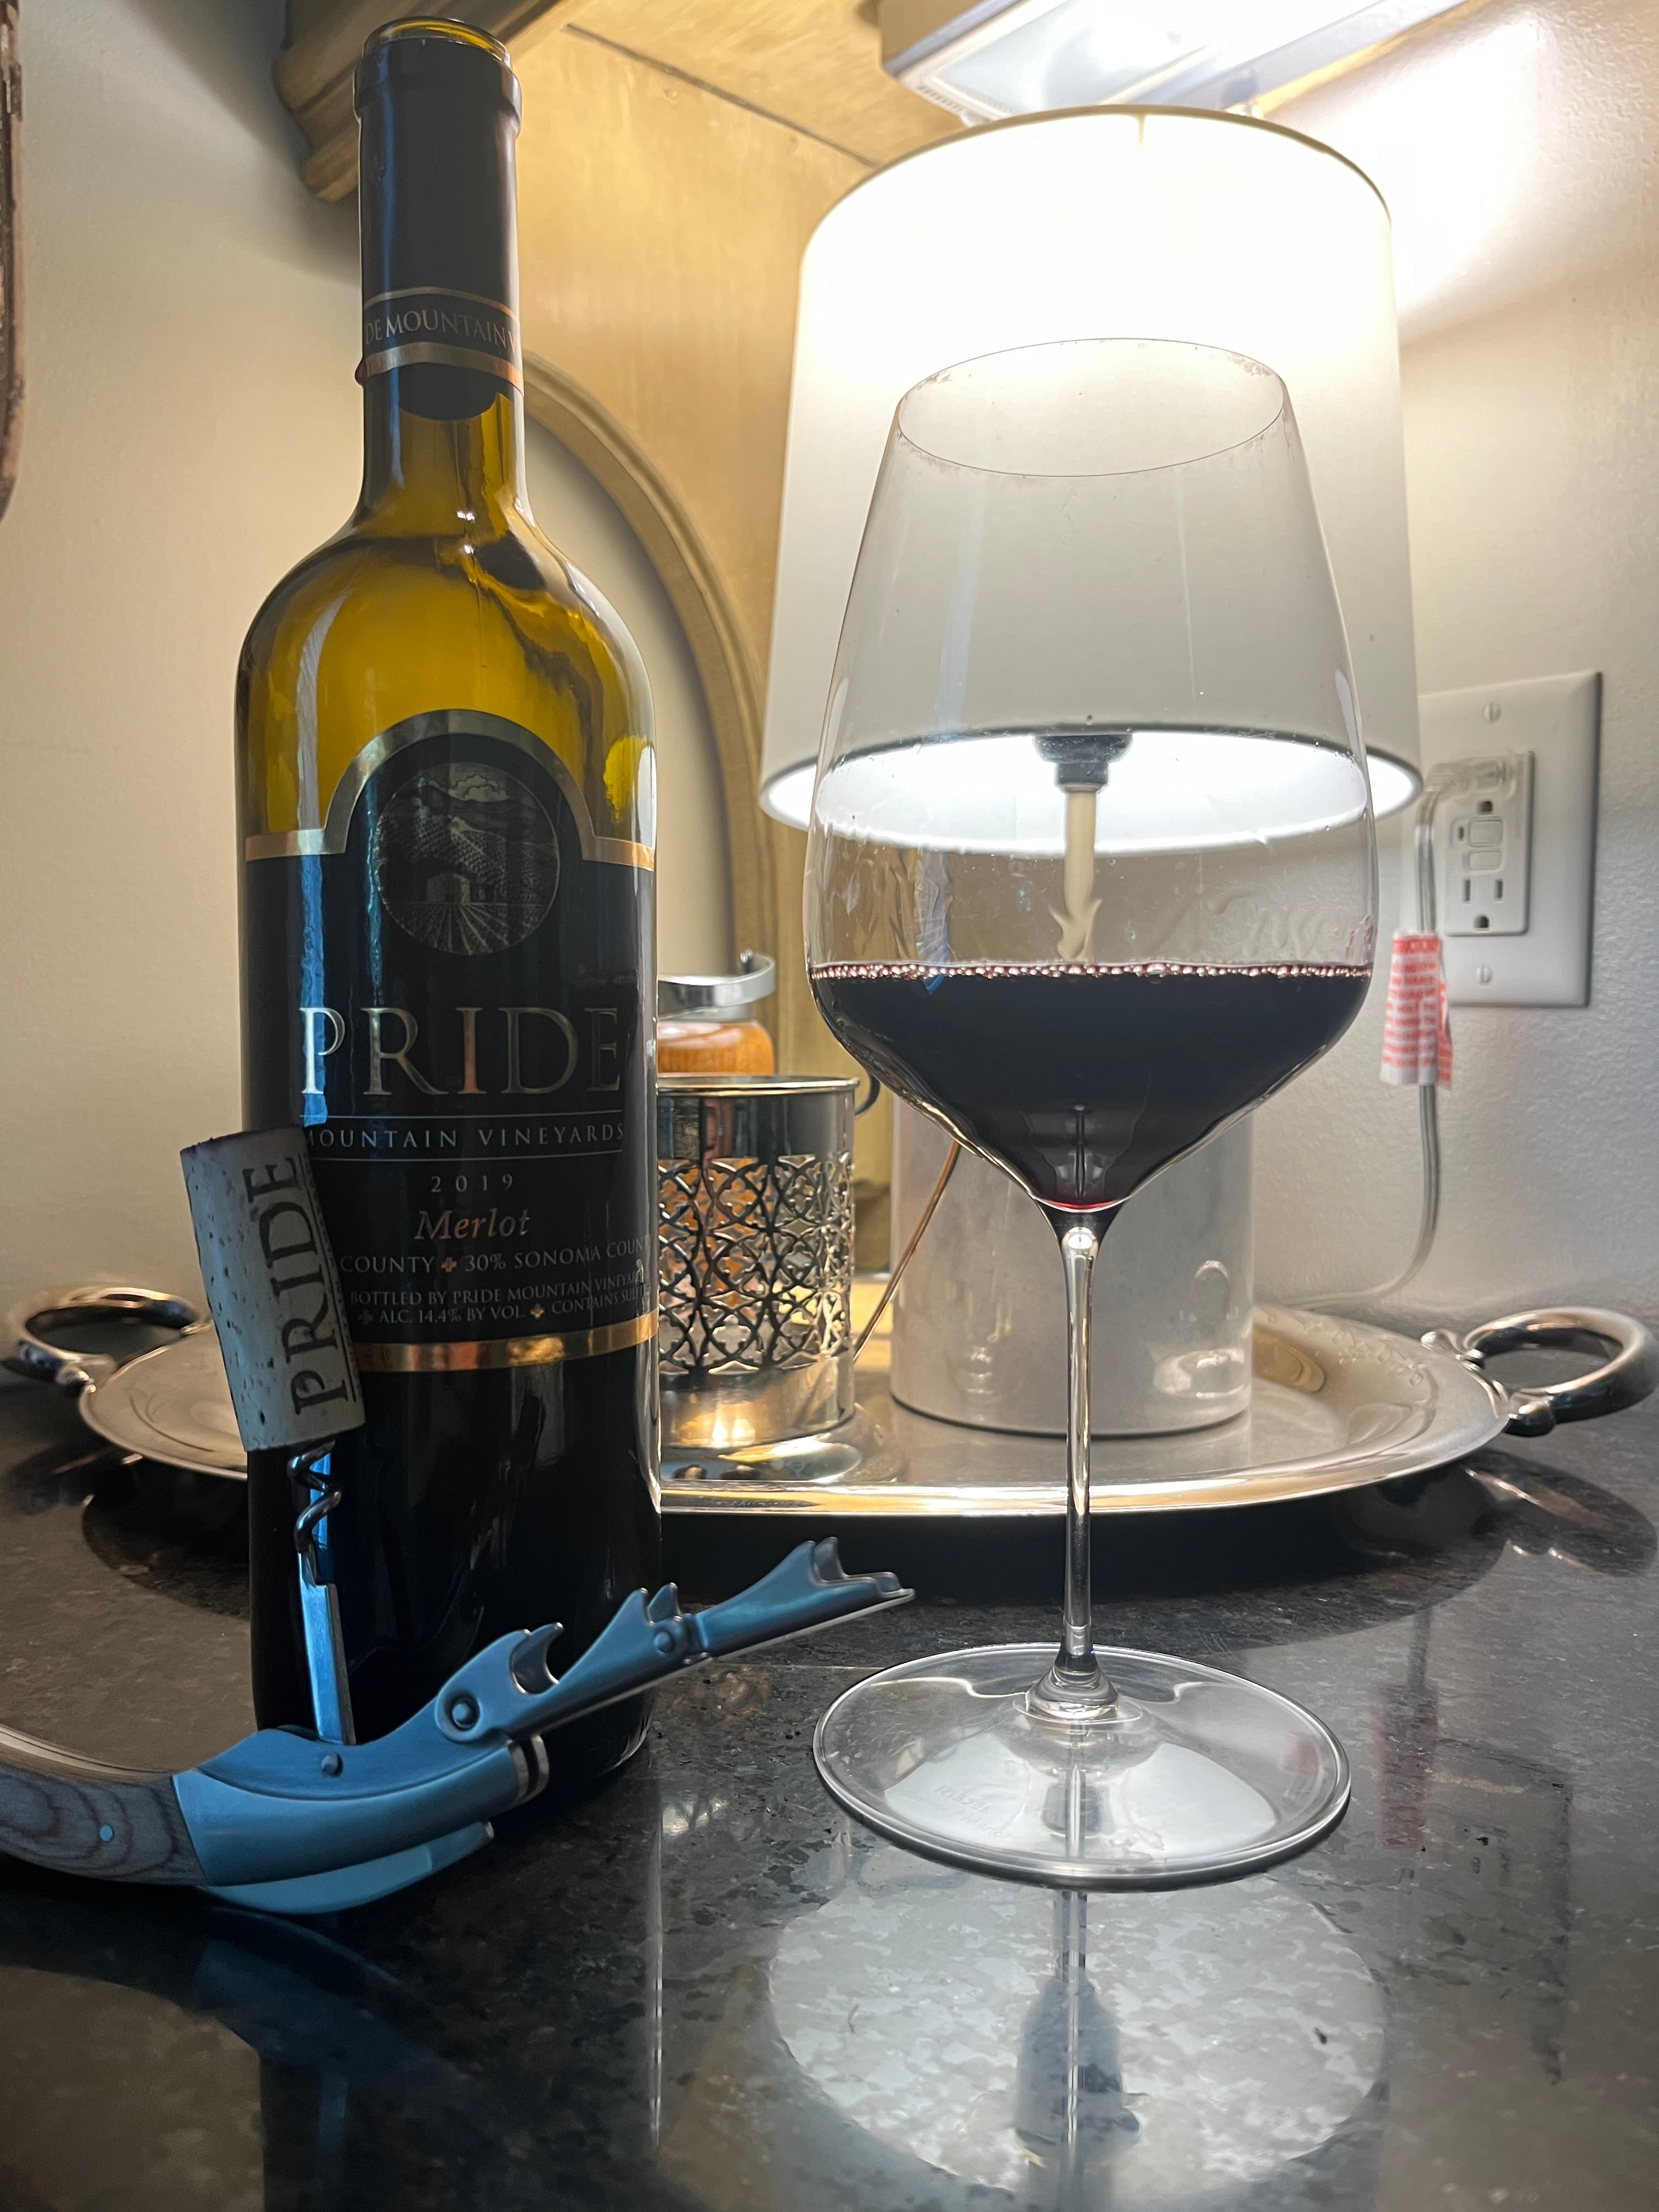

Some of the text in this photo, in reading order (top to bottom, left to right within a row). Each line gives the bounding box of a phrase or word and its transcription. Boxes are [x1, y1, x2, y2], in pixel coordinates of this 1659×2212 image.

[386, 309, 506, 349] MOUNTAIN
[299, 1007, 620, 1095] PRIDE
[478, 1122, 624, 1146] VINEYARDS
[431, 1173, 514, 1193] 2019
[414, 1207, 531, 1239] Merlot
[340, 1255, 435, 1273] COUNTY
[465, 1252, 506, 1272] 30%
[514, 1245, 601, 1269] SONOMA
[242, 1156, 350, 1415] PRIDE
[350, 1290, 422, 1306] BOTTLED
[428, 1290, 447, 1305] BY
[453, 1288, 502, 1305] PRIDE
[507, 1280, 591, 1301] MOUNTAIN
[467, 1306, 486, 1322] BY
[551, 1290, 618, 1314] CONTAINS
